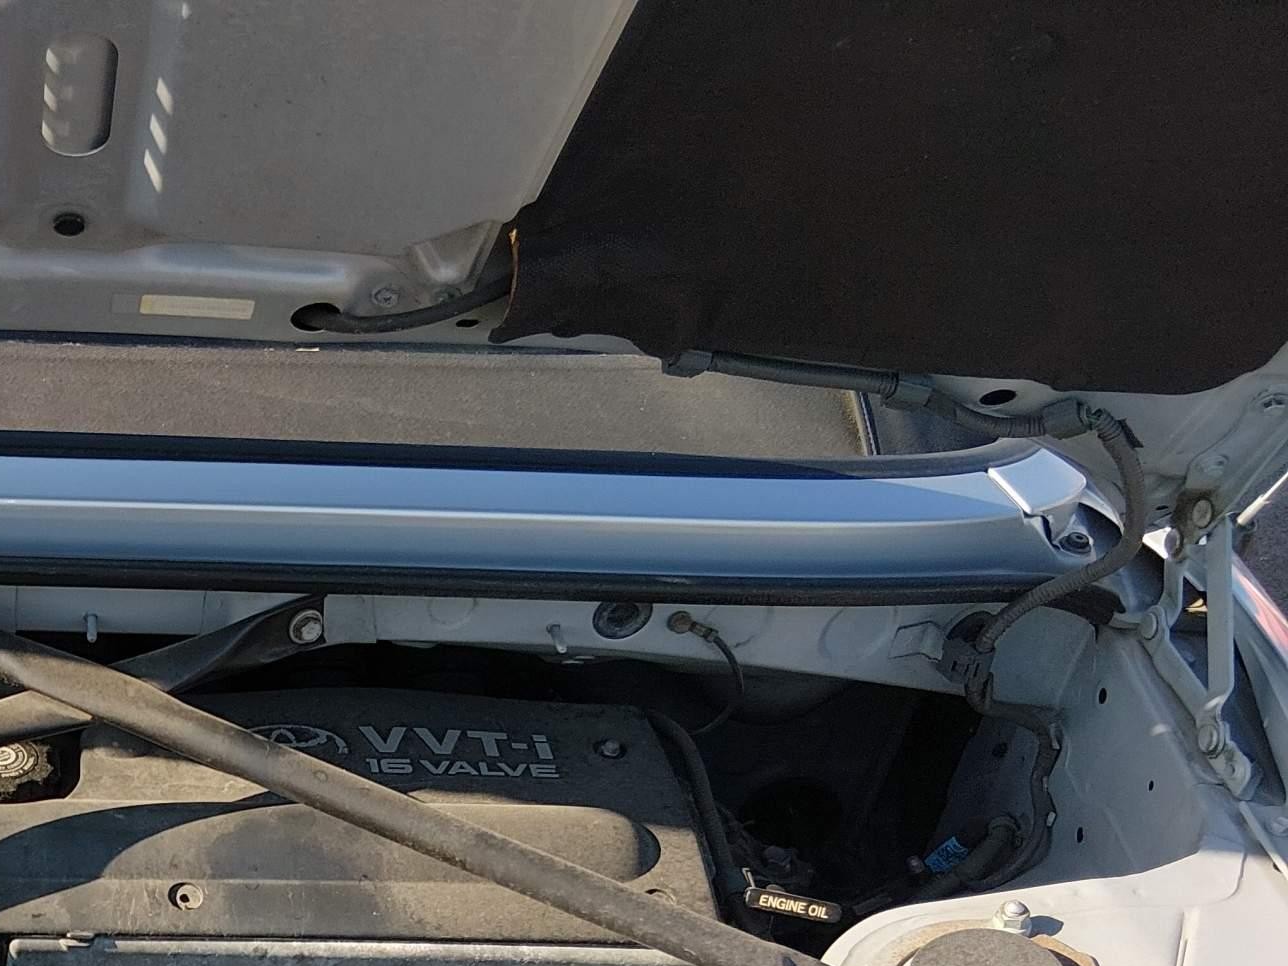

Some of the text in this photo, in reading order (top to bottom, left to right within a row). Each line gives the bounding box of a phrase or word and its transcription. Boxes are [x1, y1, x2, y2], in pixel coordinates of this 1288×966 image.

[359, 726, 554, 760] VVT-i
[366, 758, 560, 778] 16 VALVE
[759, 895, 829, 919] ENGINE OIL
